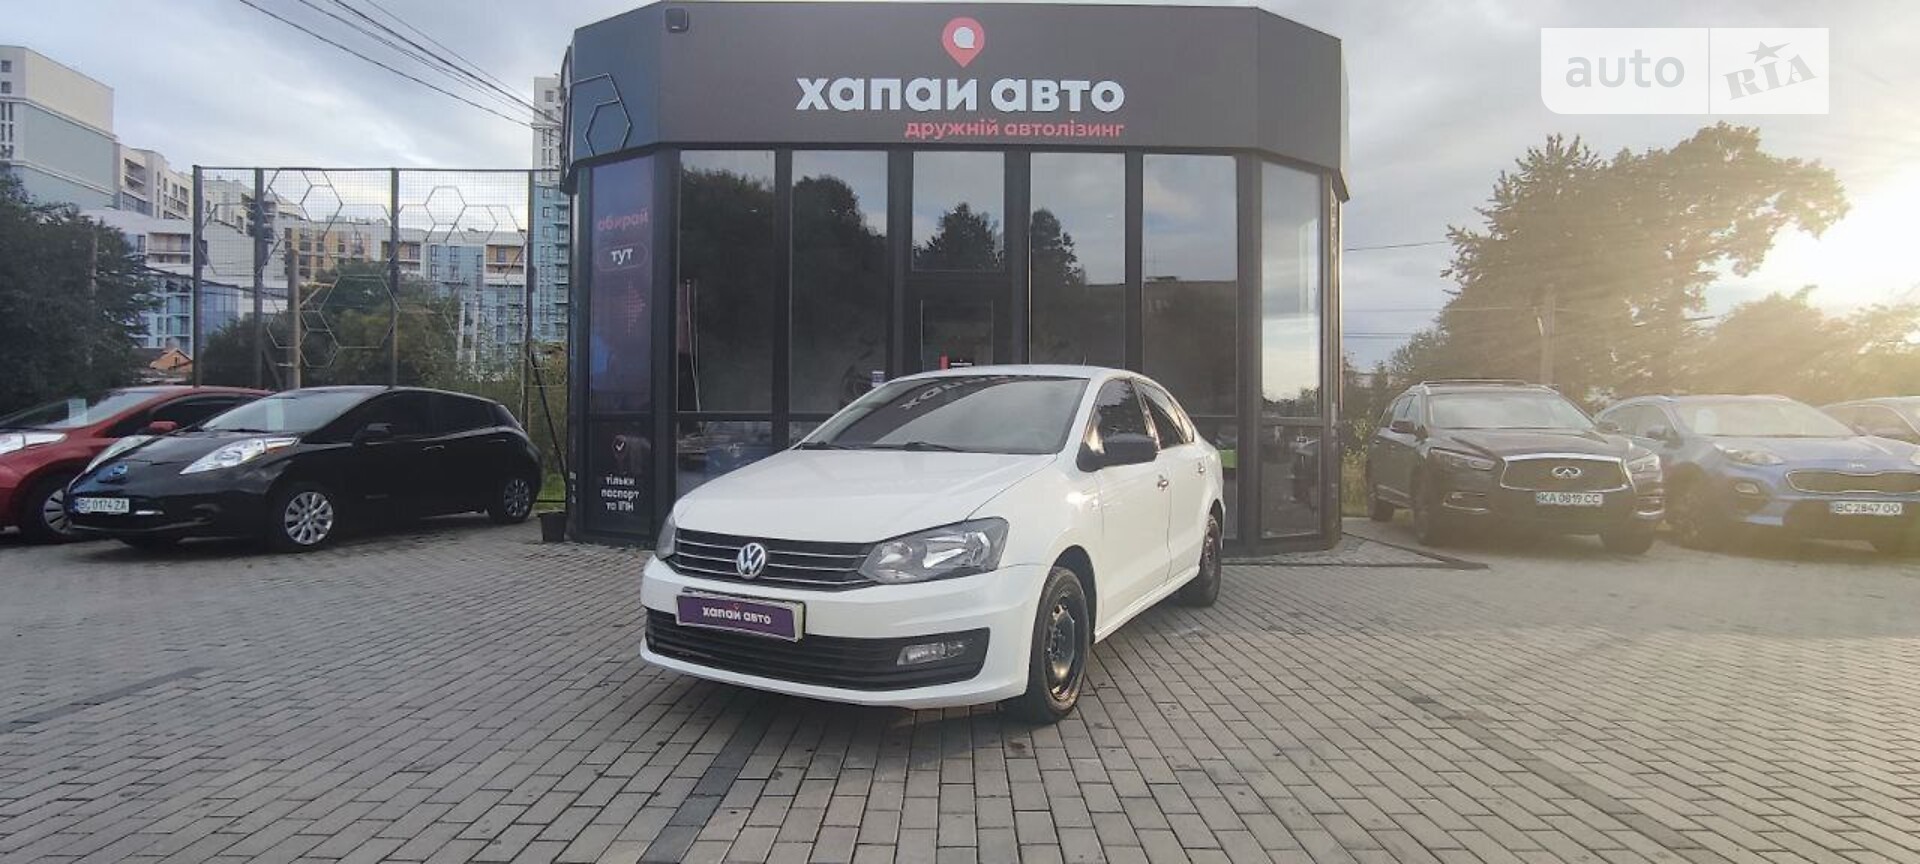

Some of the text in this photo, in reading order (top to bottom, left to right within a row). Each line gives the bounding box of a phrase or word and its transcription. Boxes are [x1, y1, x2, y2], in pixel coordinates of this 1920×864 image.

[990, 78, 1125, 112] авто
[904, 119, 1125, 139] дружній автолізинг
[611, 248, 633, 265] тут
[606, 474, 635, 486] тільки
[601, 489, 639, 501] паспорт
[743, 612, 772, 625] авто
